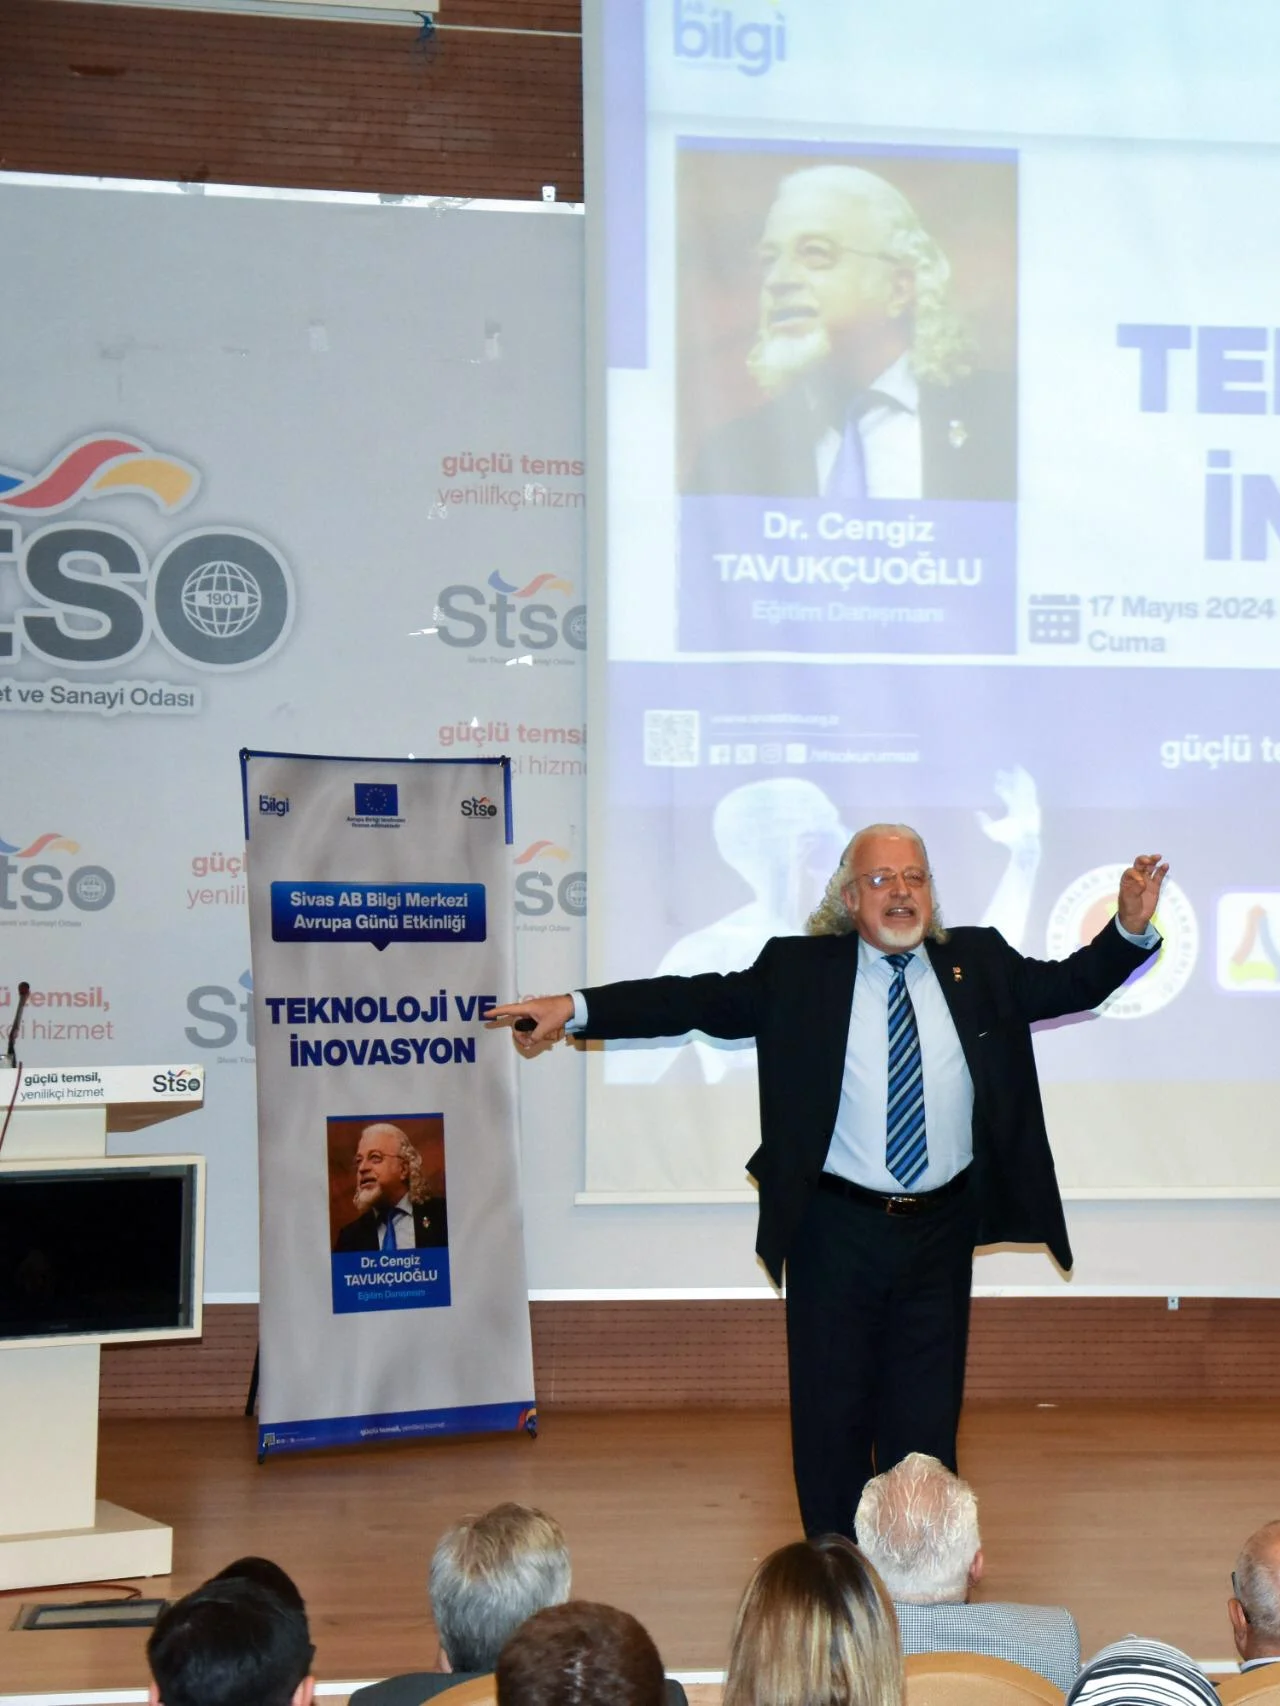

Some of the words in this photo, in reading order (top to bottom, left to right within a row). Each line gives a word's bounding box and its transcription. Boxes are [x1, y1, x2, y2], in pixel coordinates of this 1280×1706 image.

[442, 452, 513, 479] güçlü
[520, 455, 585, 477] tems
[532, 484, 586, 509] hizm
[763, 512, 808, 541] Dr.
[817, 512, 935, 549] Cengiz
[713, 552, 982, 591] TAVUKÇUOĞLU
[206, 592, 239, 606] 1901
[1088, 597, 1114, 618] 17
[1121, 597, 1199, 624] Mayıs
[1205, 598, 1277, 621] 2024
[1088, 630, 1166, 654] Cuma
[18, 689, 45, 704] ve
[51, 685, 124, 709] Sanayi
[130, 687, 195, 707] Odası
[439, 722, 510, 747] güçlü
[1160, 734, 1252, 769] güçlü
[530, 755, 587, 777] hizm
[192, 852, 248, 878] güçl
[187, 884, 246, 910] yenili
[290, 891, 334, 906] Sivas
[338, 892, 362, 906] AB
[366, 892, 401, 910] Bilgi
[405, 892, 469, 907] Merkezi
[293, 914, 352, 932] Avrupa
[355, 914, 399, 929] Günü
[403, 915, 466, 932] Etkinliği
[24, 987, 110, 1011] emsil,
[265, 989, 448, 1024] TEKNOLOJİ
[455, 995, 497, 1022] VE
[32, 1019, 114, 1041] hizmet
[290, 1033, 476, 1067] İNOVASYON
[24, 1073, 58, 1087] güçlü
[62, 1072, 101, 1084] temsil,
[21, 1088, 65, 1102] yenilikçi
[67, 1087, 105, 1099] hizmet
[360, 1257, 377, 1268] Dr.
[380, 1254, 421, 1268] Cengiz
[344, 1268, 438, 1287] TAVUKÇUOĞLU
